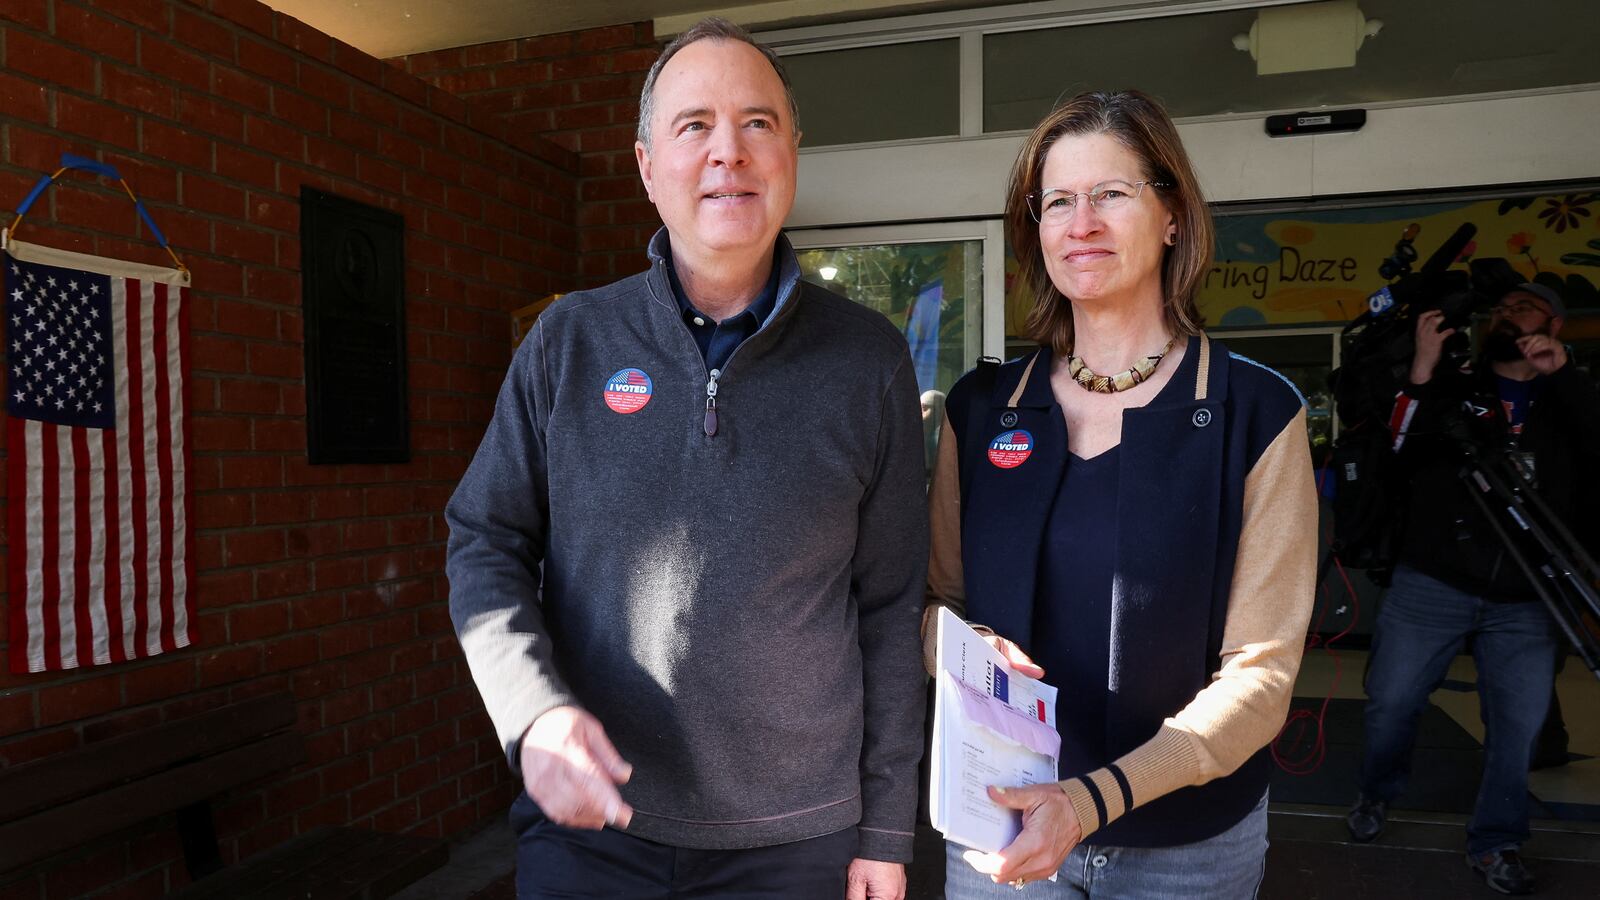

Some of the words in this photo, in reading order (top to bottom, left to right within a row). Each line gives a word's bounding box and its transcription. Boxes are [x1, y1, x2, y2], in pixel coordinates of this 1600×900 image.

[1205, 258, 1269, 299] ring
[1280, 246, 1357, 282] Daze
[609, 383, 614, 391] I
[615, 384, 647, 393] VOTED
[993, 442, 998, 450] I
[999, 443, 1029, 451] VOTED
